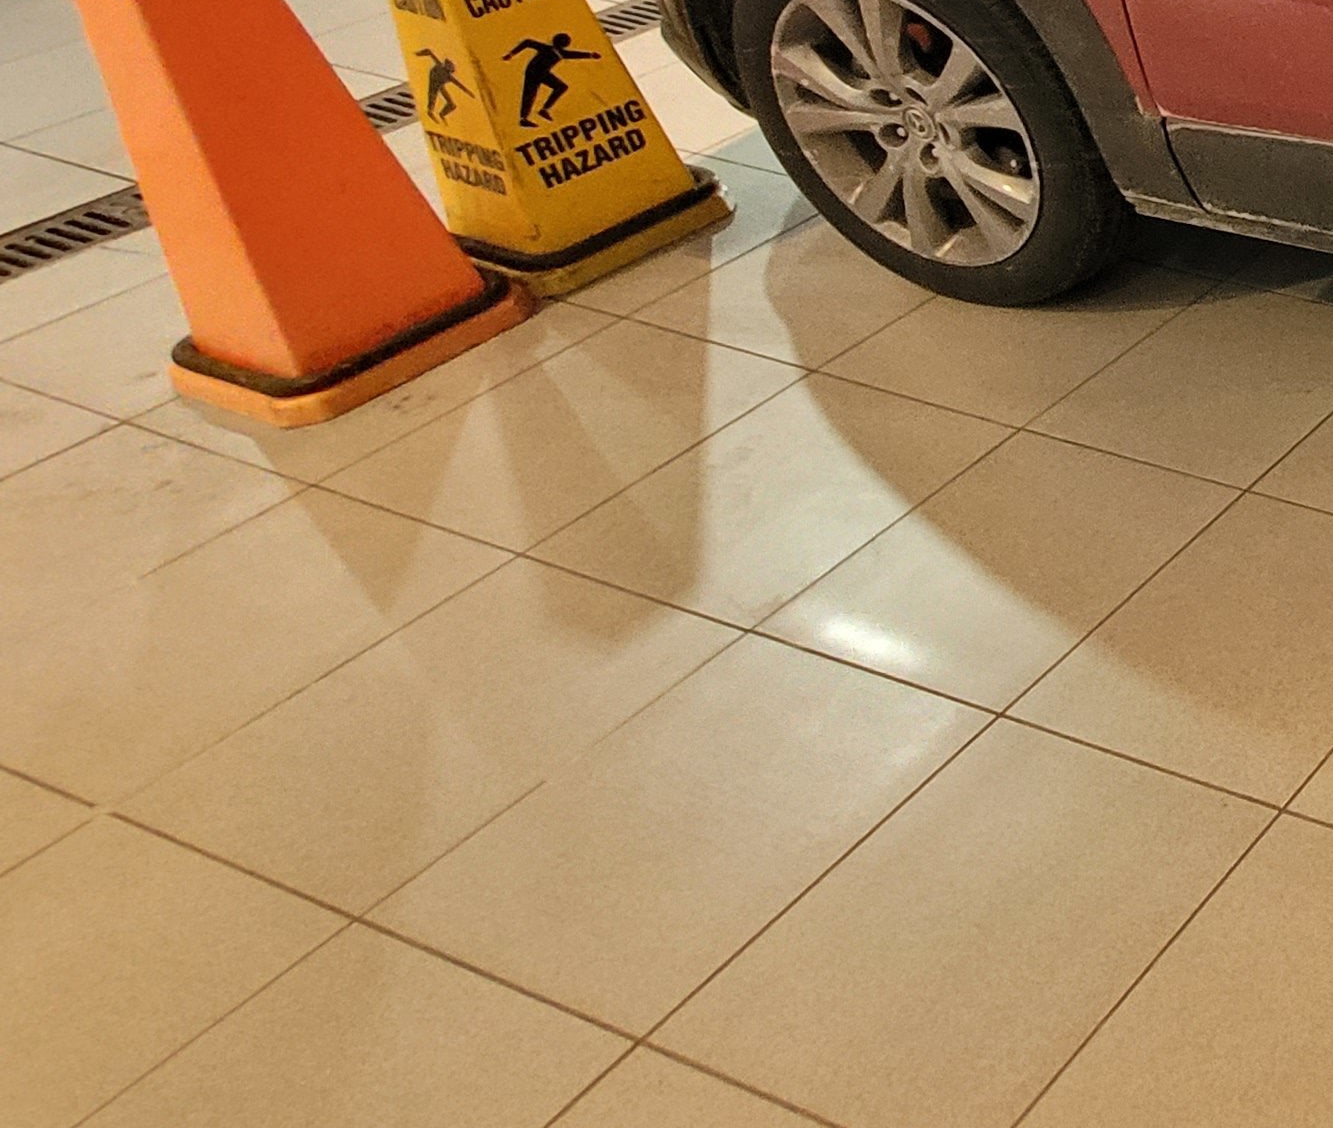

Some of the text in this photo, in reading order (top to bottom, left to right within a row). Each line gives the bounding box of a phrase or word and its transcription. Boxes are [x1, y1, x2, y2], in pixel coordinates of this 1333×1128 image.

[424, 130, 506, 171] TRIPPING
[514, 99, 647, 167] TRIPPING
[538, 128, 647, 189] HAZARD
[441, 158, 507, 196] HAZARD
